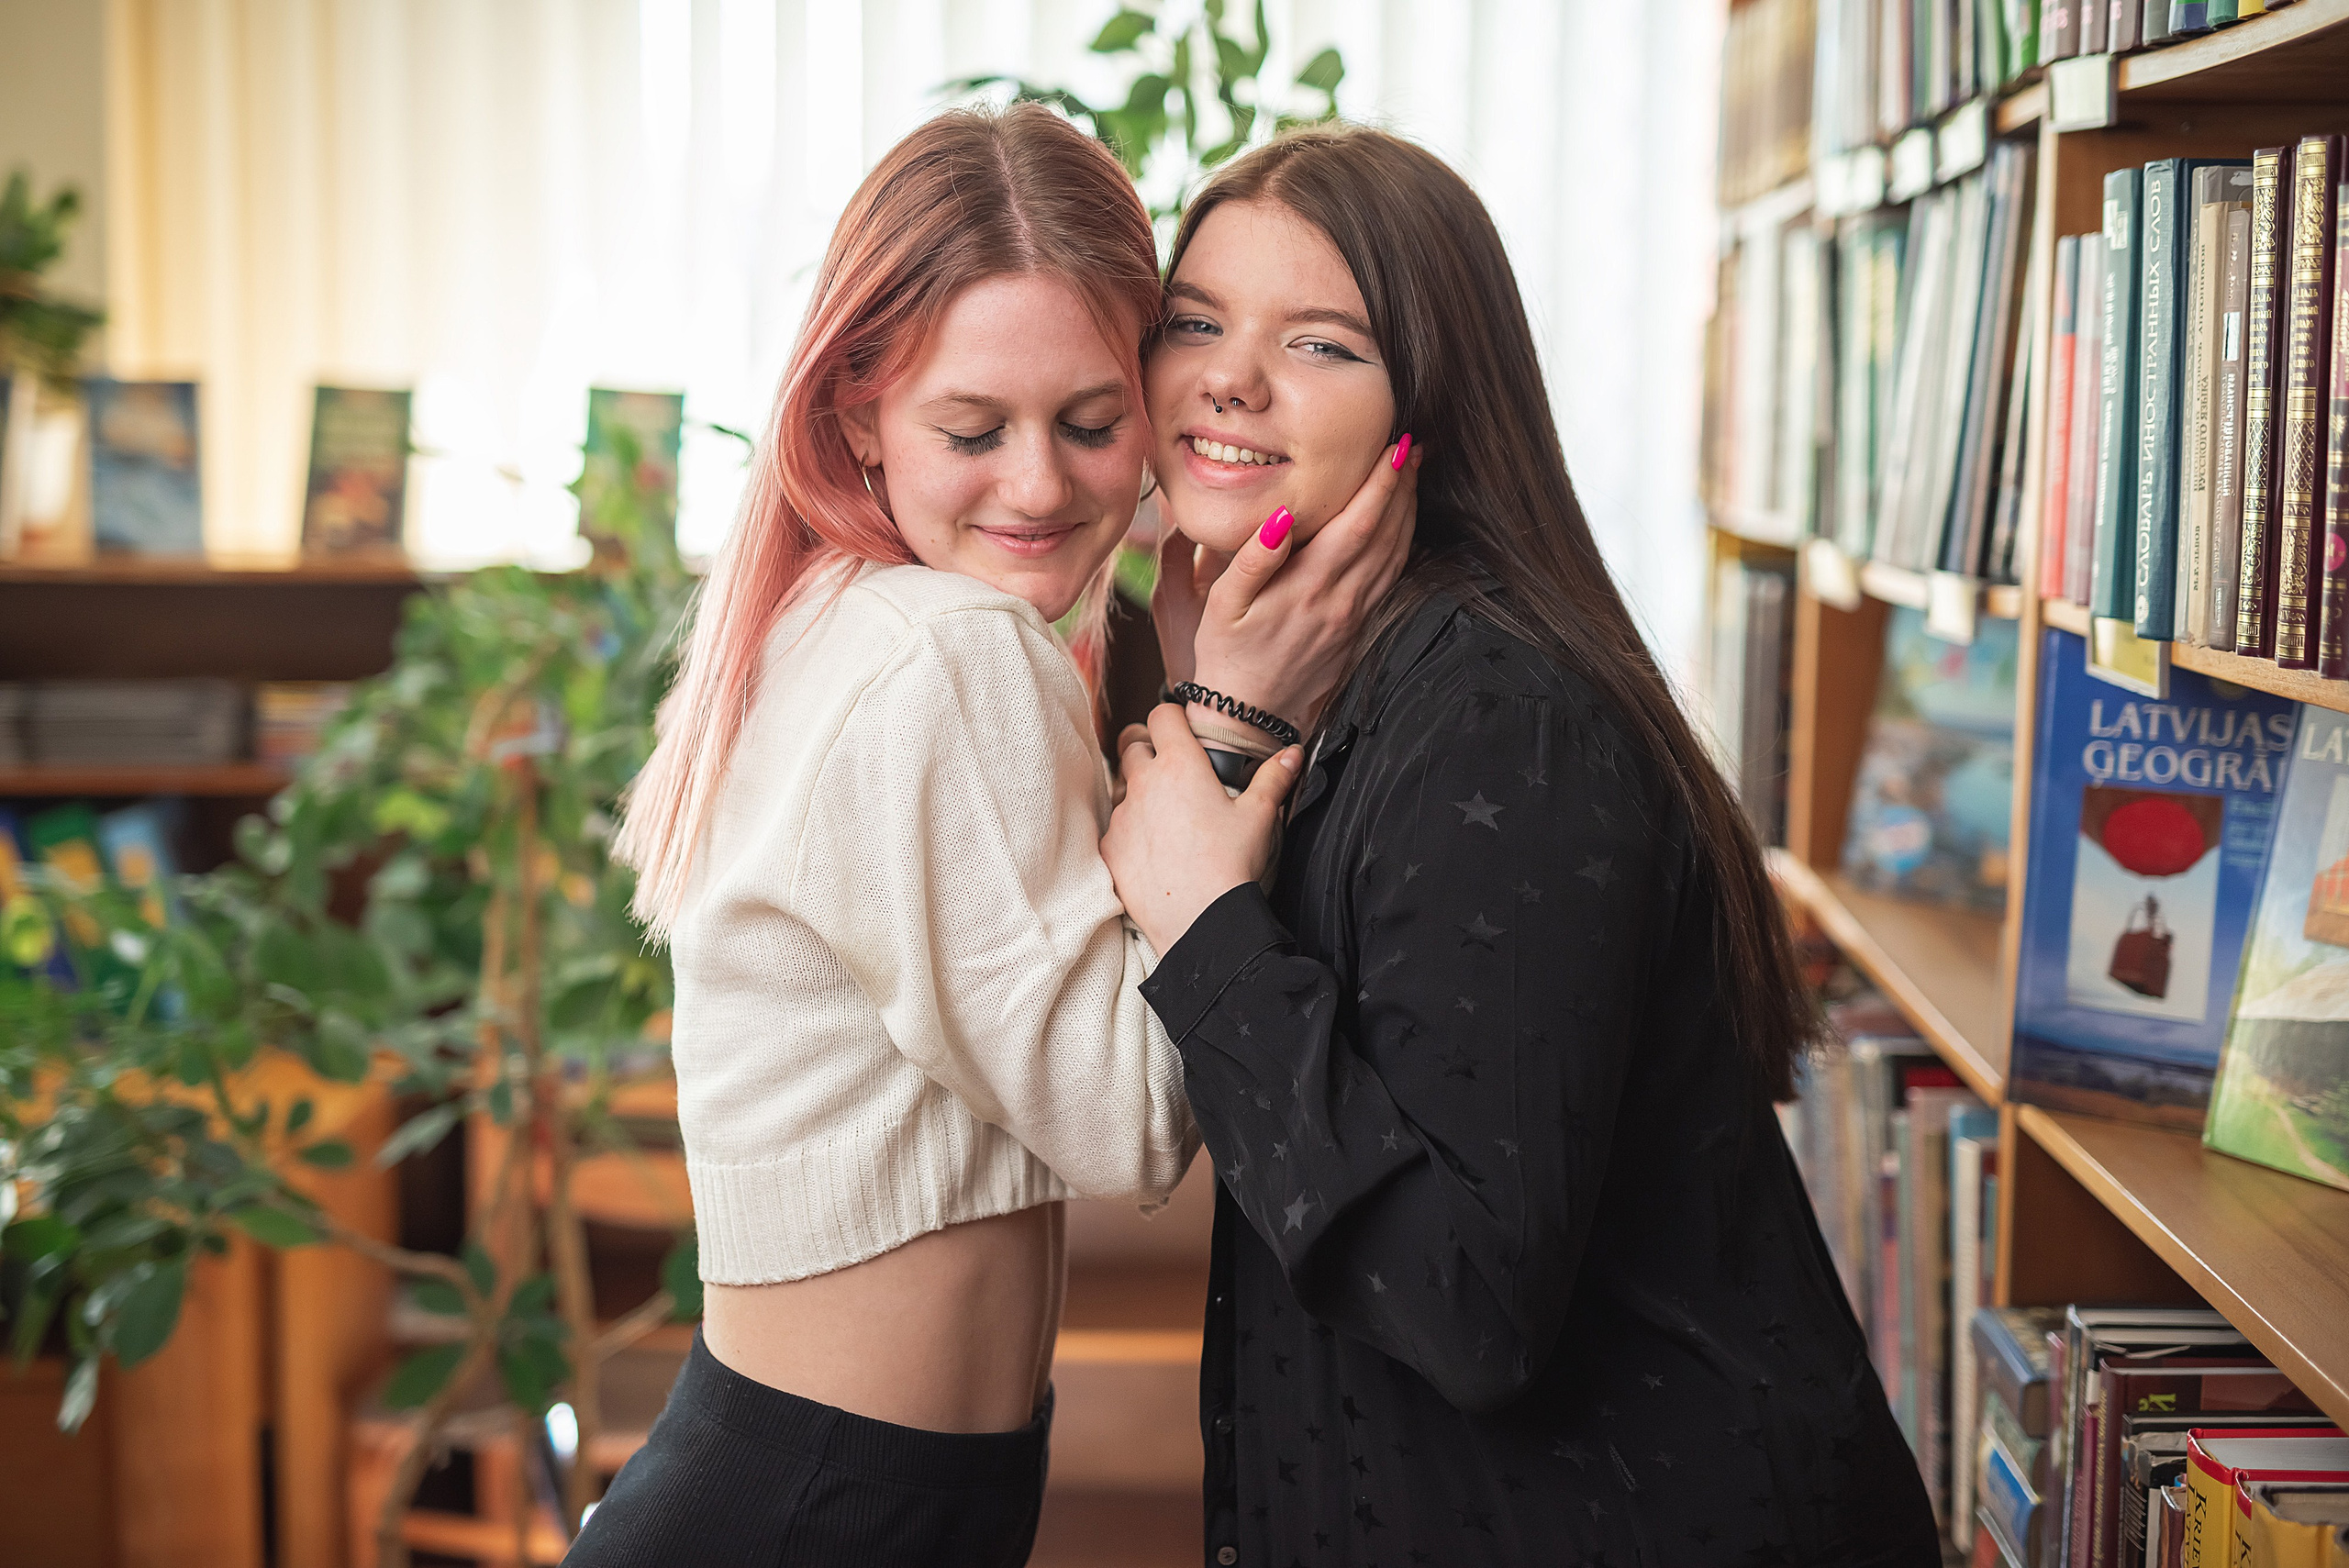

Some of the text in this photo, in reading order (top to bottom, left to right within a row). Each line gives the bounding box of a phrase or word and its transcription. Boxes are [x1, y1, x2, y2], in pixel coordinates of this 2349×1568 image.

[2138, 179, 2161, 587] СЛОВАРЬ ИНОСТРАННЫХ СЛОВ
[2199, 373, 2210, 492] РУССКОГО ЯЗЫКА
[2089, 698, 2292, 752] LATVIJAS
[2191, 1487, 2207, 1568] KRIE
